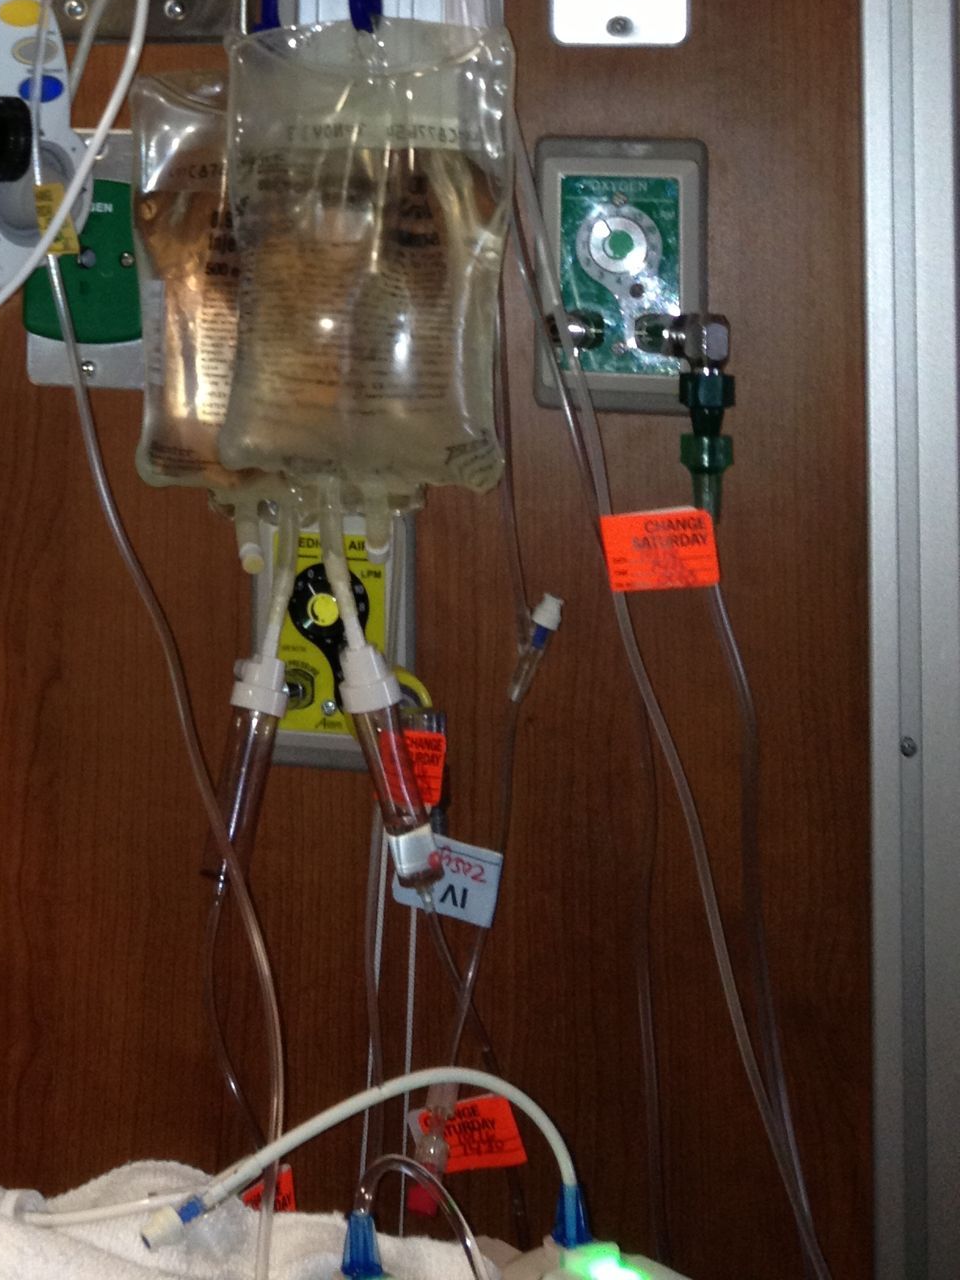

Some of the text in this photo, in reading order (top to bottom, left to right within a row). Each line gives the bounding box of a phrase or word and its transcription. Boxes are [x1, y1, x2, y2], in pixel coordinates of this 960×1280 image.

[643, 516, 706, 534] CHANGE
[631, 532, 708, 551] SATURDAY
[439, 883, 470, 910] IV
